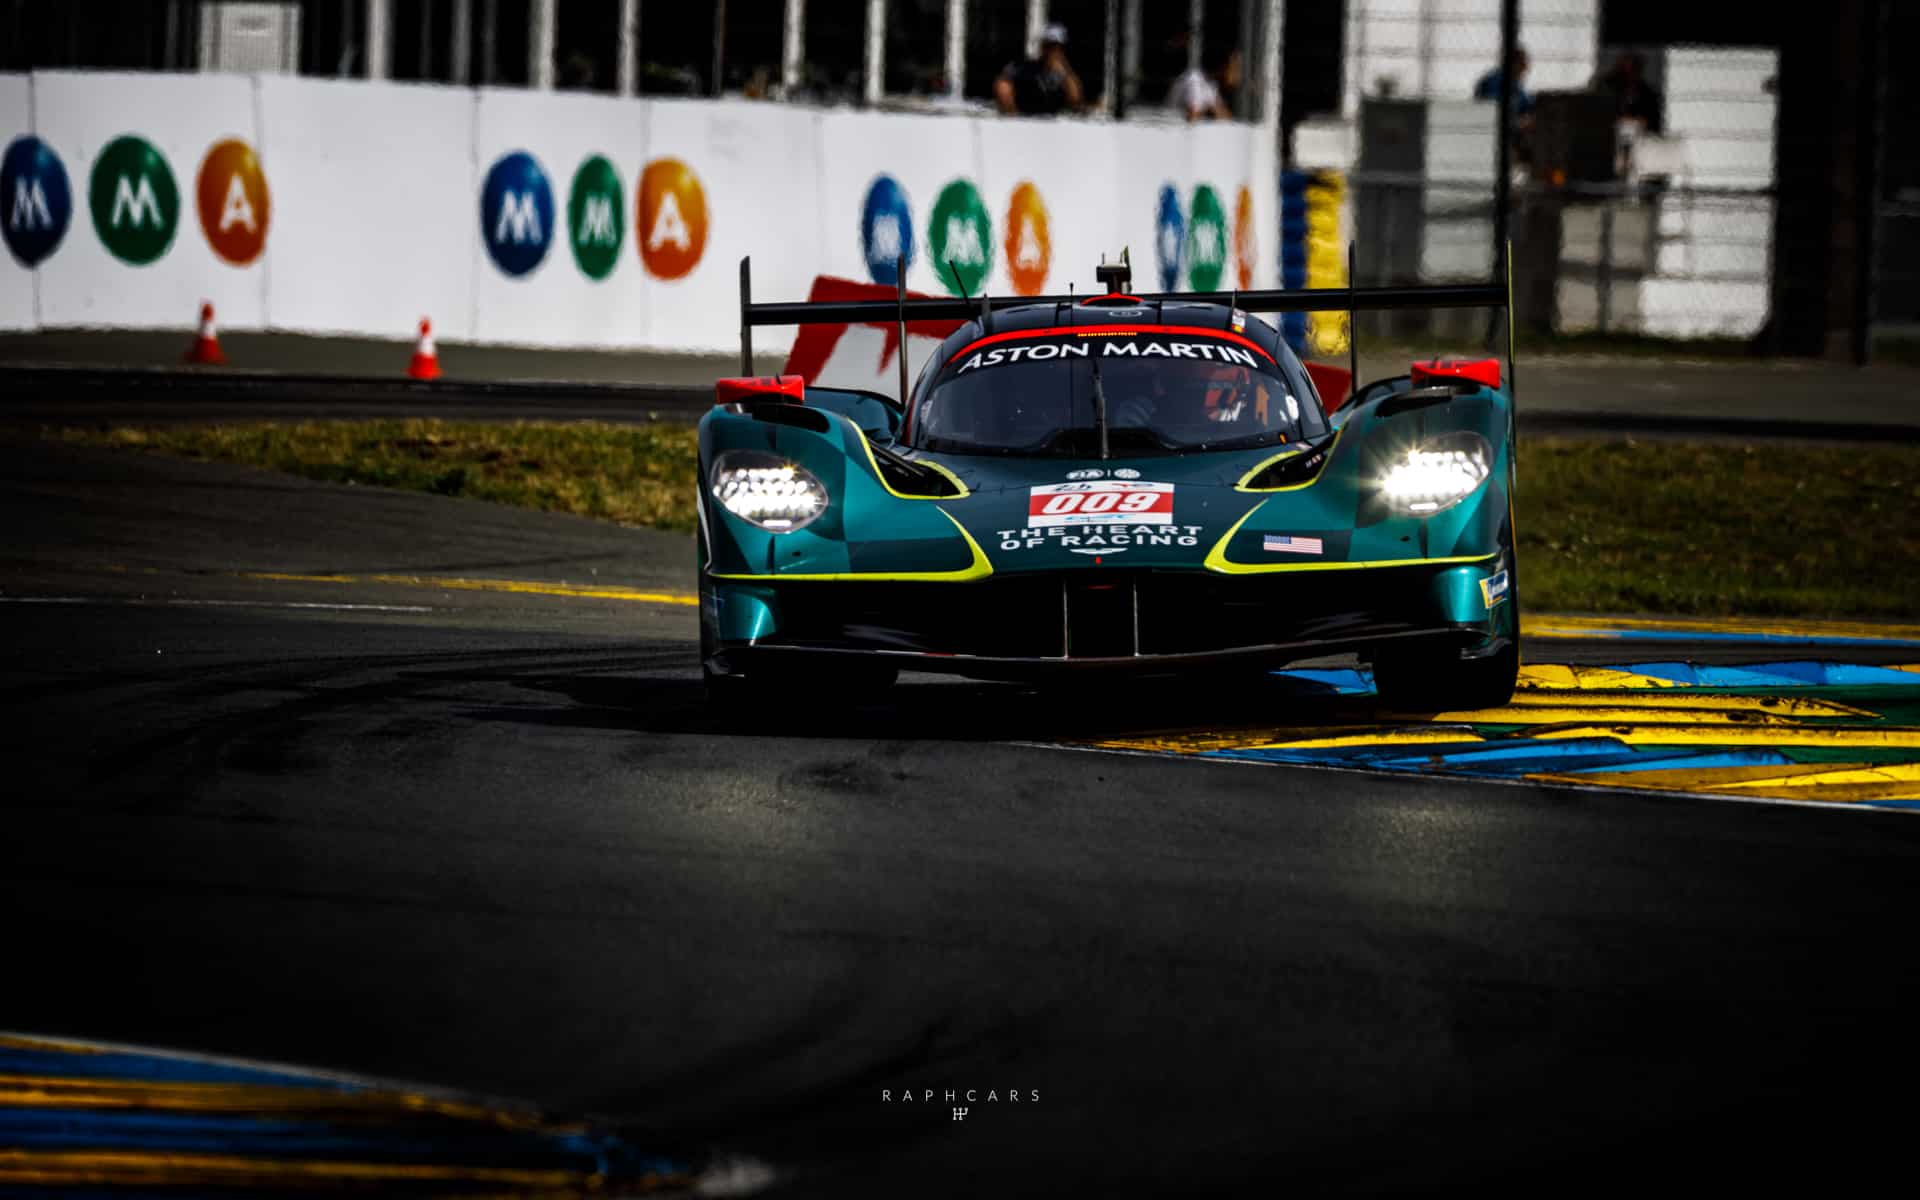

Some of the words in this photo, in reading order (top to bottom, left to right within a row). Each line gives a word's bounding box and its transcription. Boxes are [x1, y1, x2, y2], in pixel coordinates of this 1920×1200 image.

[957, 343, 1089, 373] ASTON
[1102, 342, 1258, 368] MARTIN
[1042, 493, 1160, 514] 009
[997, 527, 1067, 539] THE
[1083, 525, 1202, 535] HEART
[1000, 537, 1044, 549] OF
[1061, 535, 1199, 546] RACING
